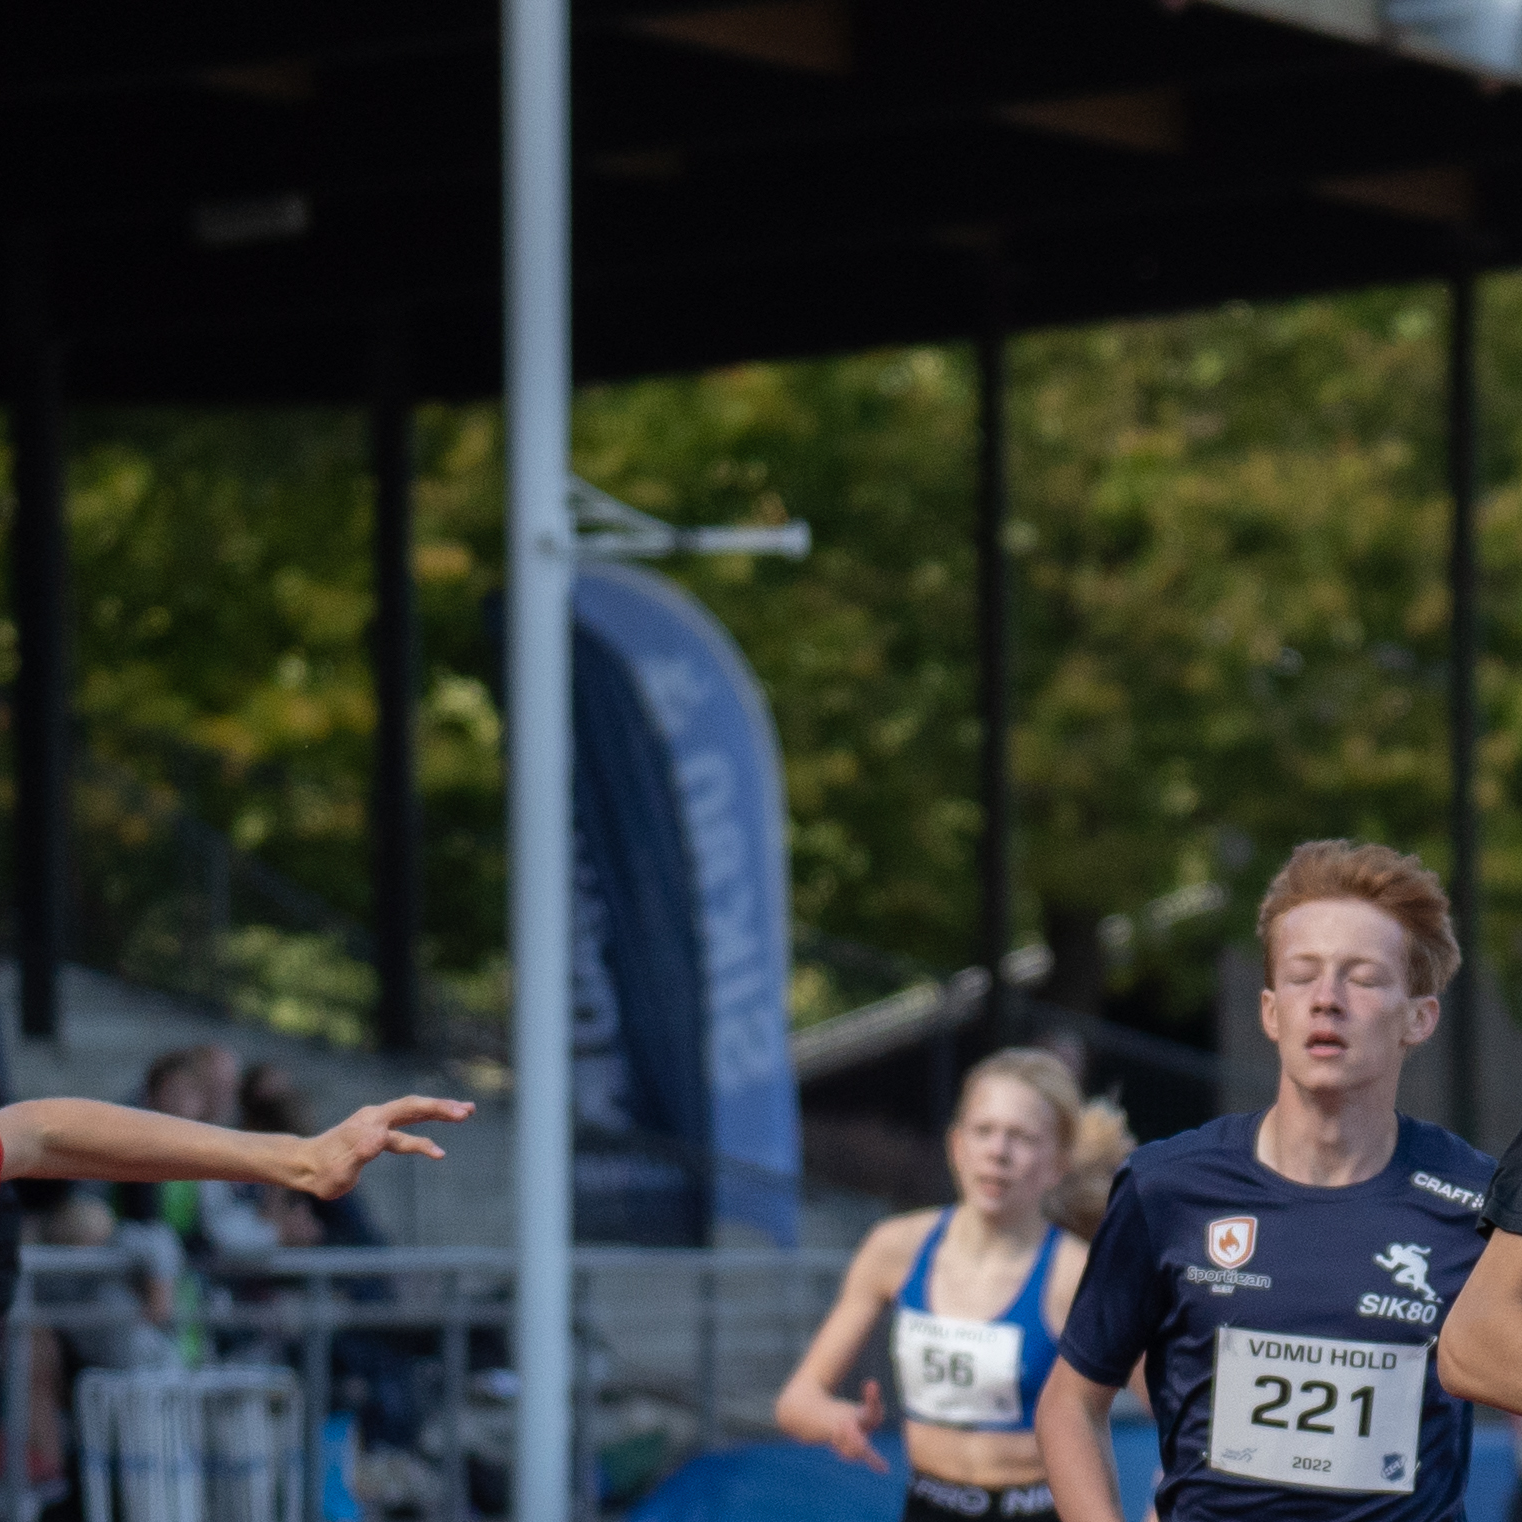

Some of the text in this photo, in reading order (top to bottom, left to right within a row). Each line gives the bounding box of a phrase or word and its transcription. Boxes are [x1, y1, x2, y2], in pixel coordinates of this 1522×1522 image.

[1413, 1171, 1474, 1204] CRAFT
[1358, 1293, 1438, 1324] SIK80
[923, 1346, 975, 1387] 56
[1248, 1338, 1397, 1370] VDMU HOLD
[1251, 1374, 1375, 1438] 221
[1292, 1456, 1332, 1472] 2022
